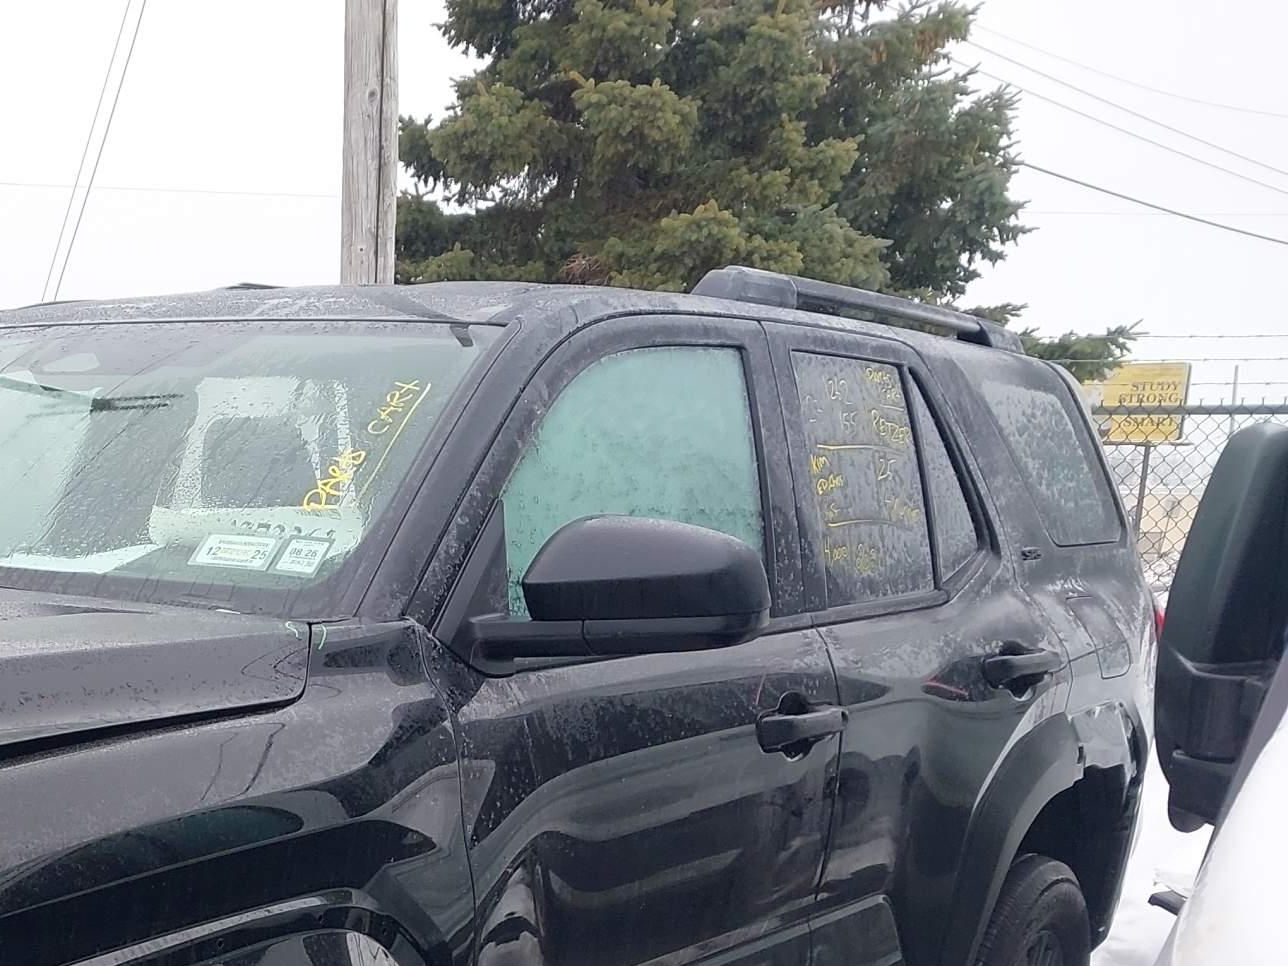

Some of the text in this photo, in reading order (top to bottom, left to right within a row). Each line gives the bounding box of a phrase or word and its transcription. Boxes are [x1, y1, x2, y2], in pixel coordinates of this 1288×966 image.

[1130, 381, 1181, 392] STUDY
[1118, 393, 1180, 404] STRONG
[205, 545, 222, 556] 12
[250, 549, 268, 560] 25
